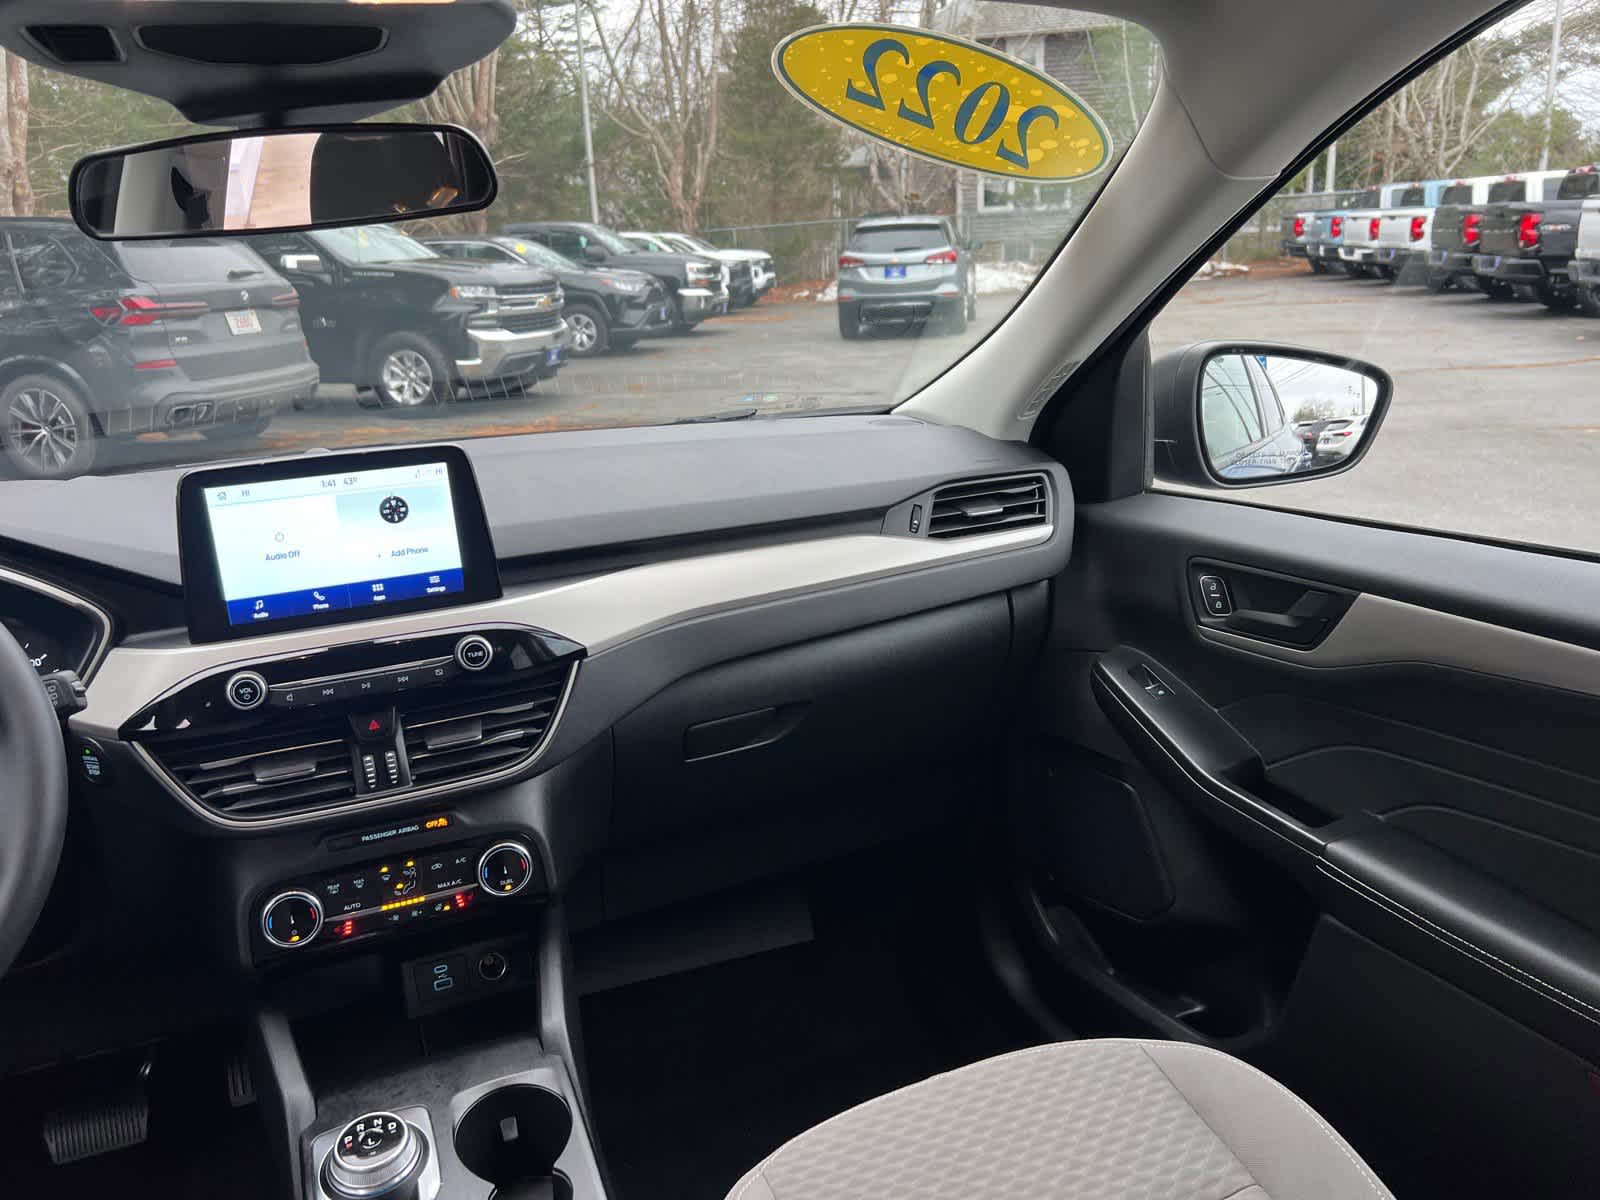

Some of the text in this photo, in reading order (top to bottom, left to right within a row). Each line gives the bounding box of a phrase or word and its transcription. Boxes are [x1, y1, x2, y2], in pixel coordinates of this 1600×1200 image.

[265, 549, 301, 560] Audio Off
[391, 546, 429, 557] Add Phone
[239, 687, 253, 695] VOL
[361, 819, 440, 842] PASSENGER AIRBAG OFF
[455, 856, 467, 864] A/C
[437, 878, 463, 889] MAX A/C
[343, 902, 361, 911] AUTO
[343, 1117, 397, 1144] P R N D
[367, 1137, 375, 1146] L
